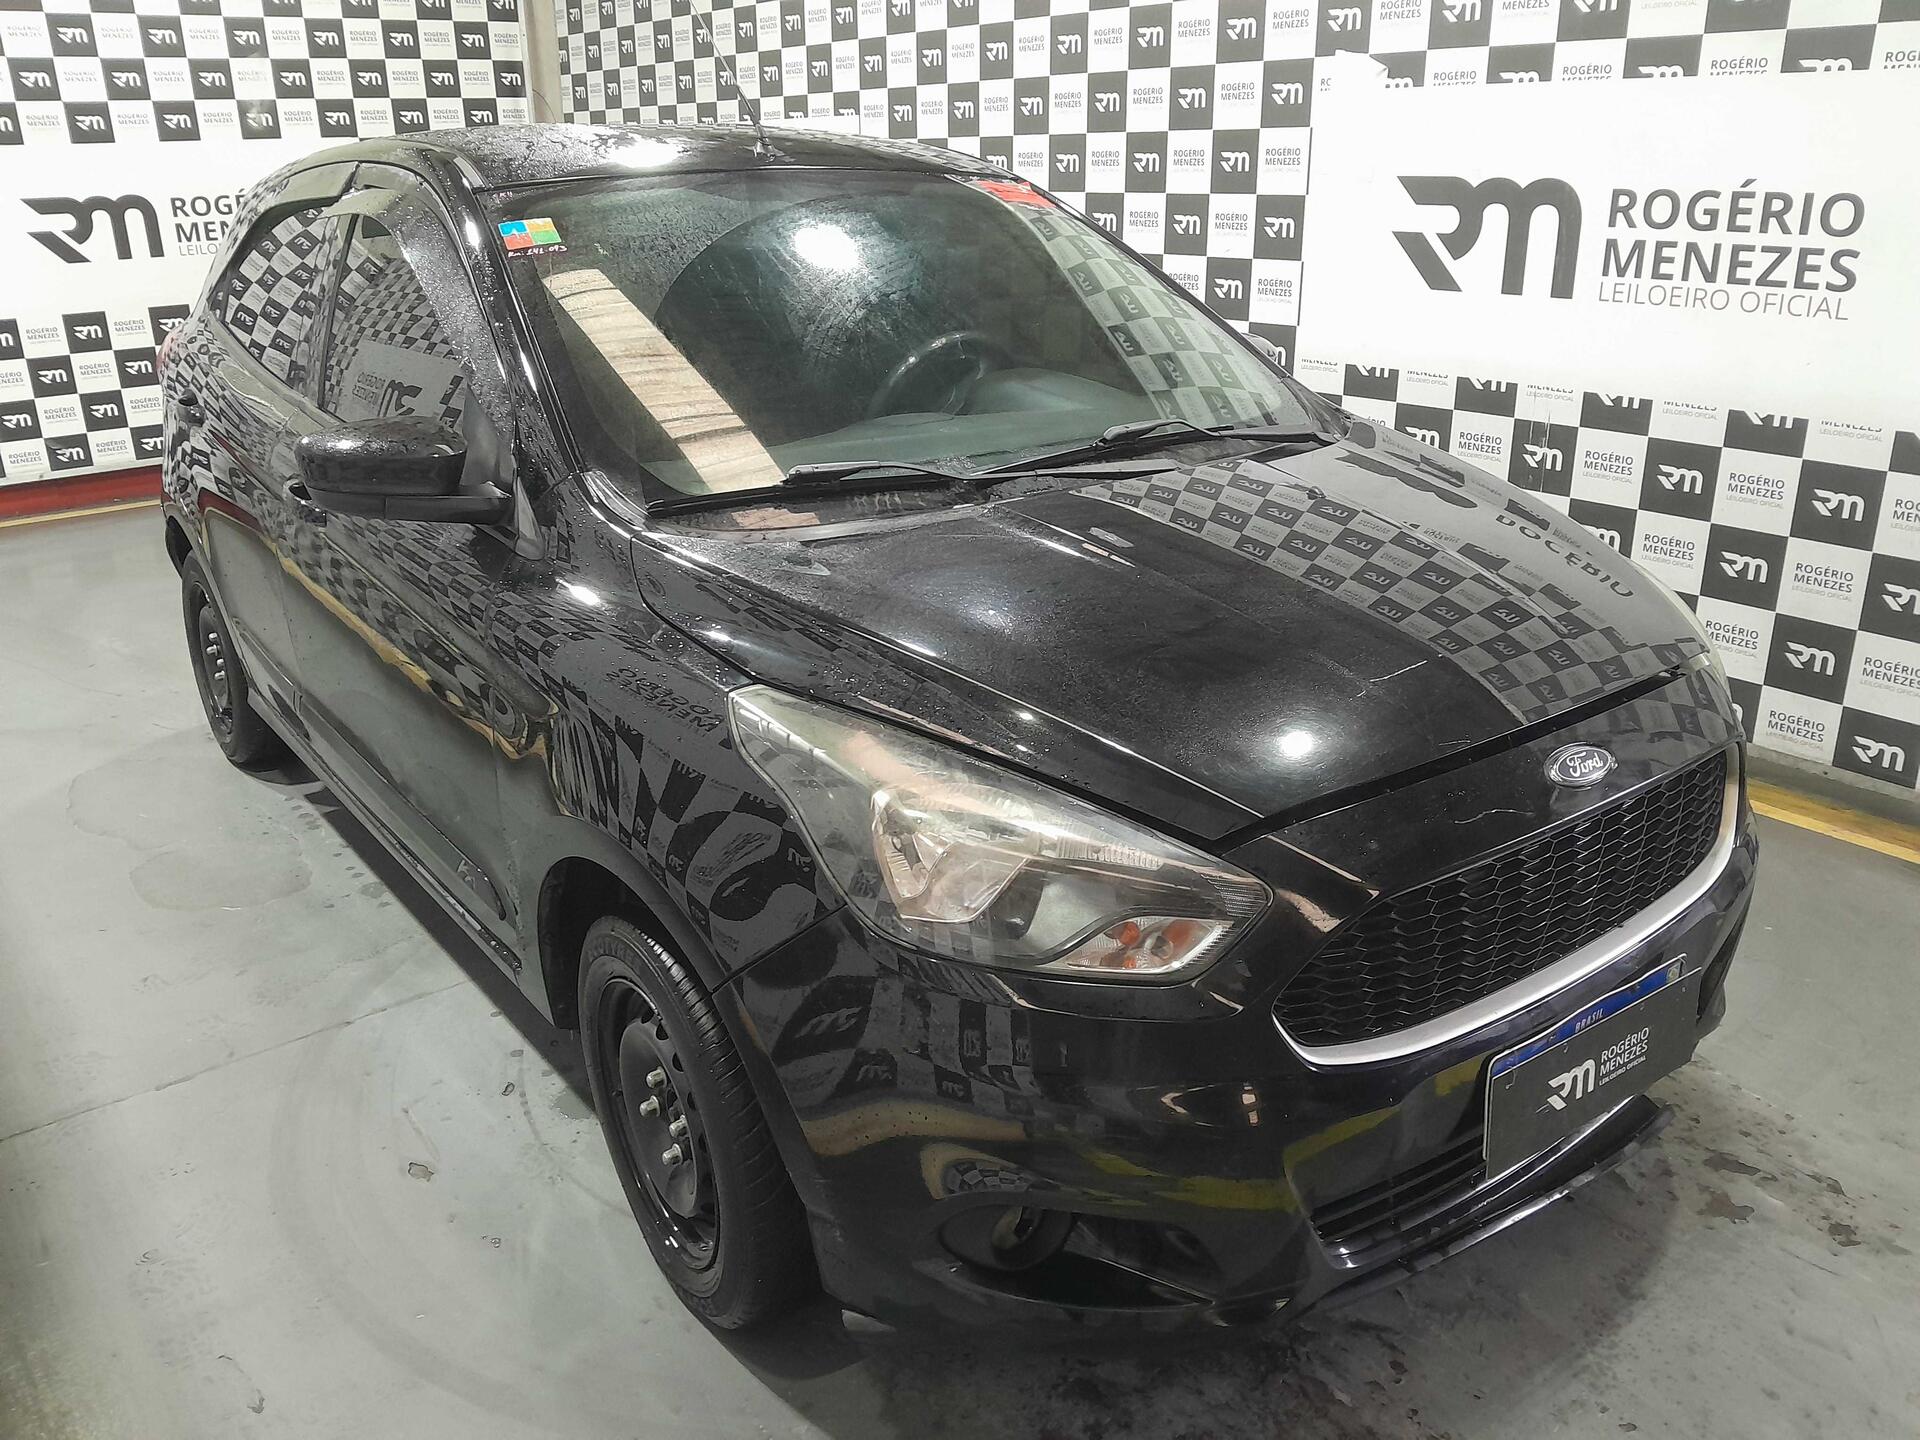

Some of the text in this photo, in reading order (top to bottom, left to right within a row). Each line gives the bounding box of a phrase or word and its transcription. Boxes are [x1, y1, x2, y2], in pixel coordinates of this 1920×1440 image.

[1380, 9, 1421, 20] MENEZES
[1273, 18, 1309, 29] MENEZES
[1178, 28, 1210, 37] MENEZES
[1563, 64, 1612, 75] ROGÉRIO
[1711, 56, 1768, 70] ROGÉRIO
[1133, 96, 1163, 104] MENEZES
[1221, 92, 1254, 100] MENEZES
[1055, 100, 1081, 108] MENEZES
[1266, 148, 1300, 156] ROGÉRIO
[1173, 158, 1204, 166] MENEZES
[1265, 157, 1300, 165] MENEZES
[1608, 178, 1865, 237] ROGÉRIO
[1130, 211, 1158, 219] ROGÉRIO
[1215, 213, 1248, 222] ROGÉRIO
[1215, 222, 1248, 230] MENEZES
[1602, 238, 1860, 293] MENEZES
[1258, 278, 1292, 288] ROGÉRIO
[1258, 288, 1292, 297] MENEZES
[1598, 282, 1848, 321] LEILOEIRO OFICIAL
[1662, 408, 1718, 420] LEILOEIRO OFICIAL
[1460, 432, 1502, 445] ROGÉRIO
[1820, 427, 1883, 442] LEILOEIRO OFICIAL
[96, 440, 126, 448] ROGÉRIO
[1459, 441, 1502, 455] MENEZES
[8, 451, 40, 459] ROGÉRIO
[1585, 450, 1633, 465] ROGÉRIO
[1584, 460, 1632, 476] MENEZES
[1730, 472, 1784, 489] ROGÉRIO
[1728, 483, 1784, 500] MENEZES
[1644, 534, 1694, 550] ROGÉRIO
[1643, 544, 1694, 561] MENEZES
[1796, 563, 1853, 582] ROGÉRIO
[1794, 573, 1852, 593] MENEZES
[1706, 620, 1758, 639] ROGÉRIO
[1707, 630, 1758, 650] MENEZES
[1862, 668, 1920, 689] MENEZES
[1770, 710, 1824, 732] ROGÉRIO
[1767, 720, 1824, 742] MENEZES
[1566, 752, 1603, 777] Ford
[1575, 1008, 1603, 1033] BRASIL
[1601, 1028, 1649, 1062] ROGÉRIO
[1600, 1040, 1648, 1076] MENEZES
